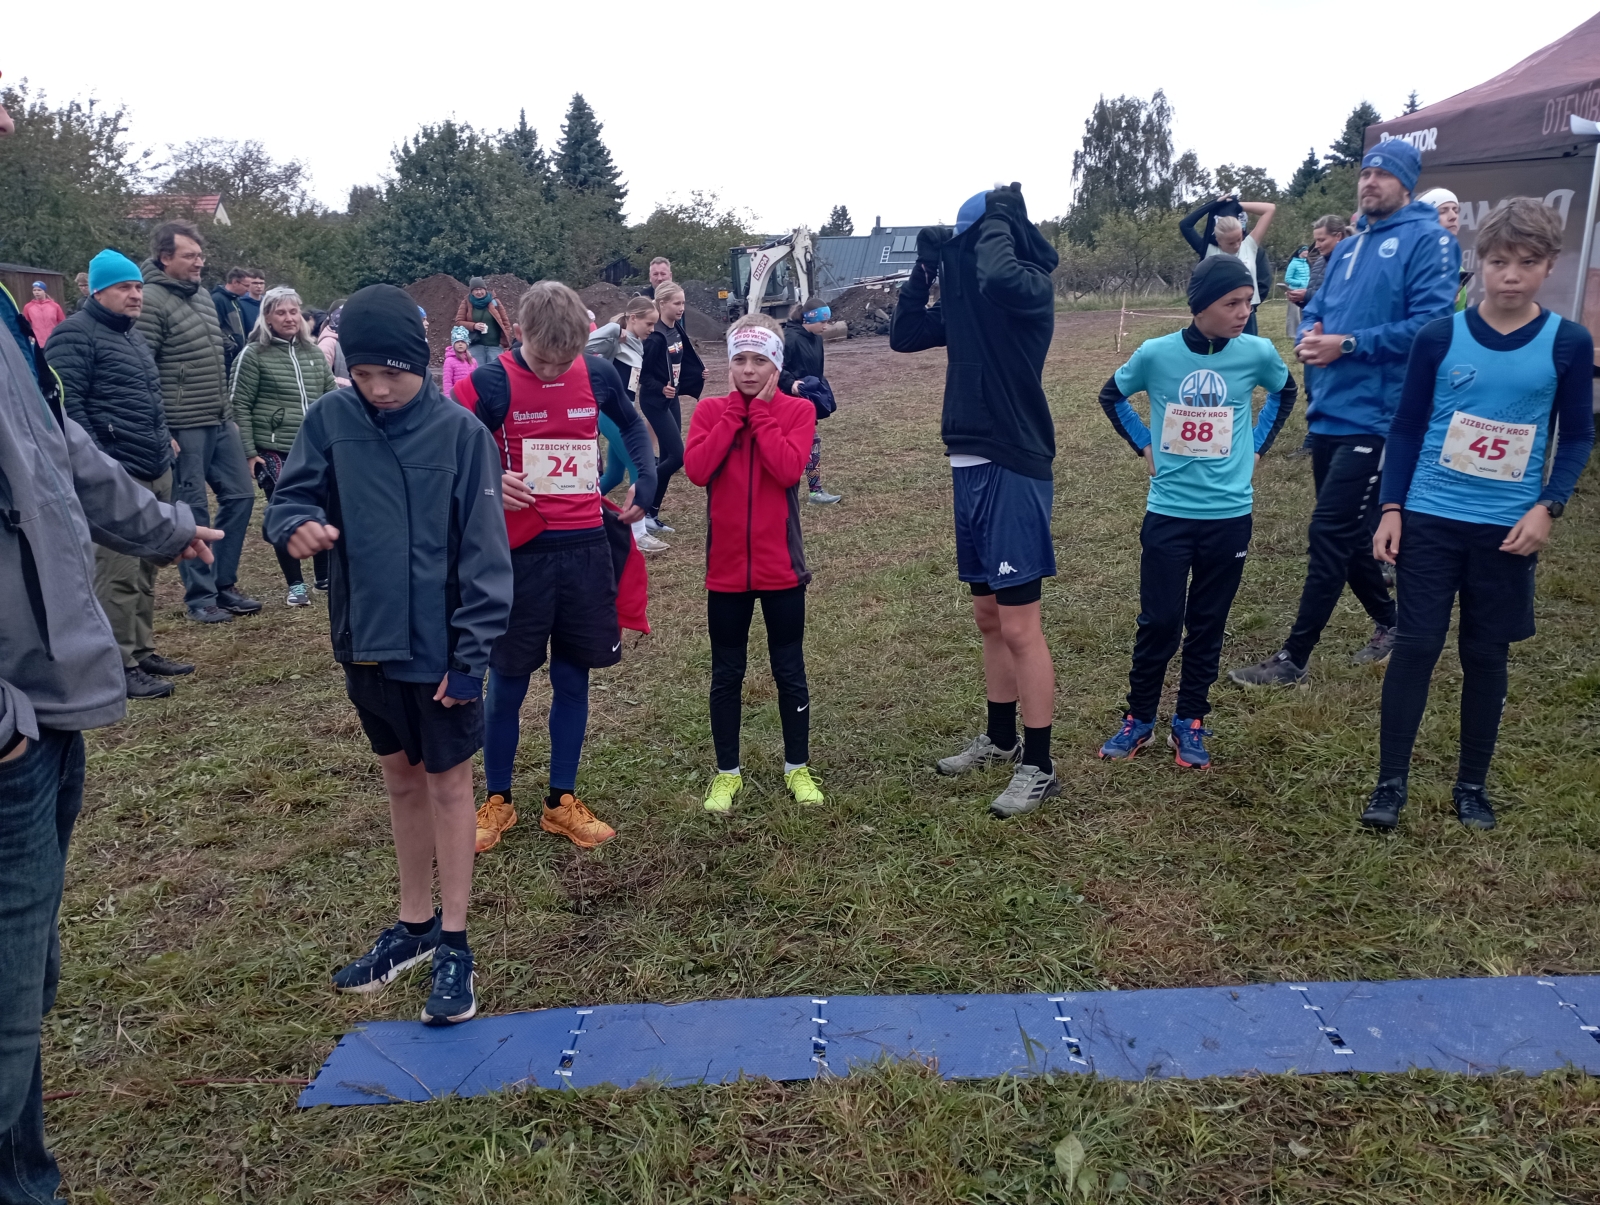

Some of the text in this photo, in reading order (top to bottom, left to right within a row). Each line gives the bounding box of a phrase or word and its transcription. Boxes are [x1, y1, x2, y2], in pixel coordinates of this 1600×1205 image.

[753, 254, 769, 280] DISPA
[1172, 408, 1207, 418] JIZBICKÝ
[1181, 421, 1213, 443] 88
[1460, 417, 1530, 436] JIZBICKÝ KROS
[530, 442, 570, 451] JIZBICKÝ
[1468, 435, 1510, 461] 45
[547, 455, 578, 477] 24
